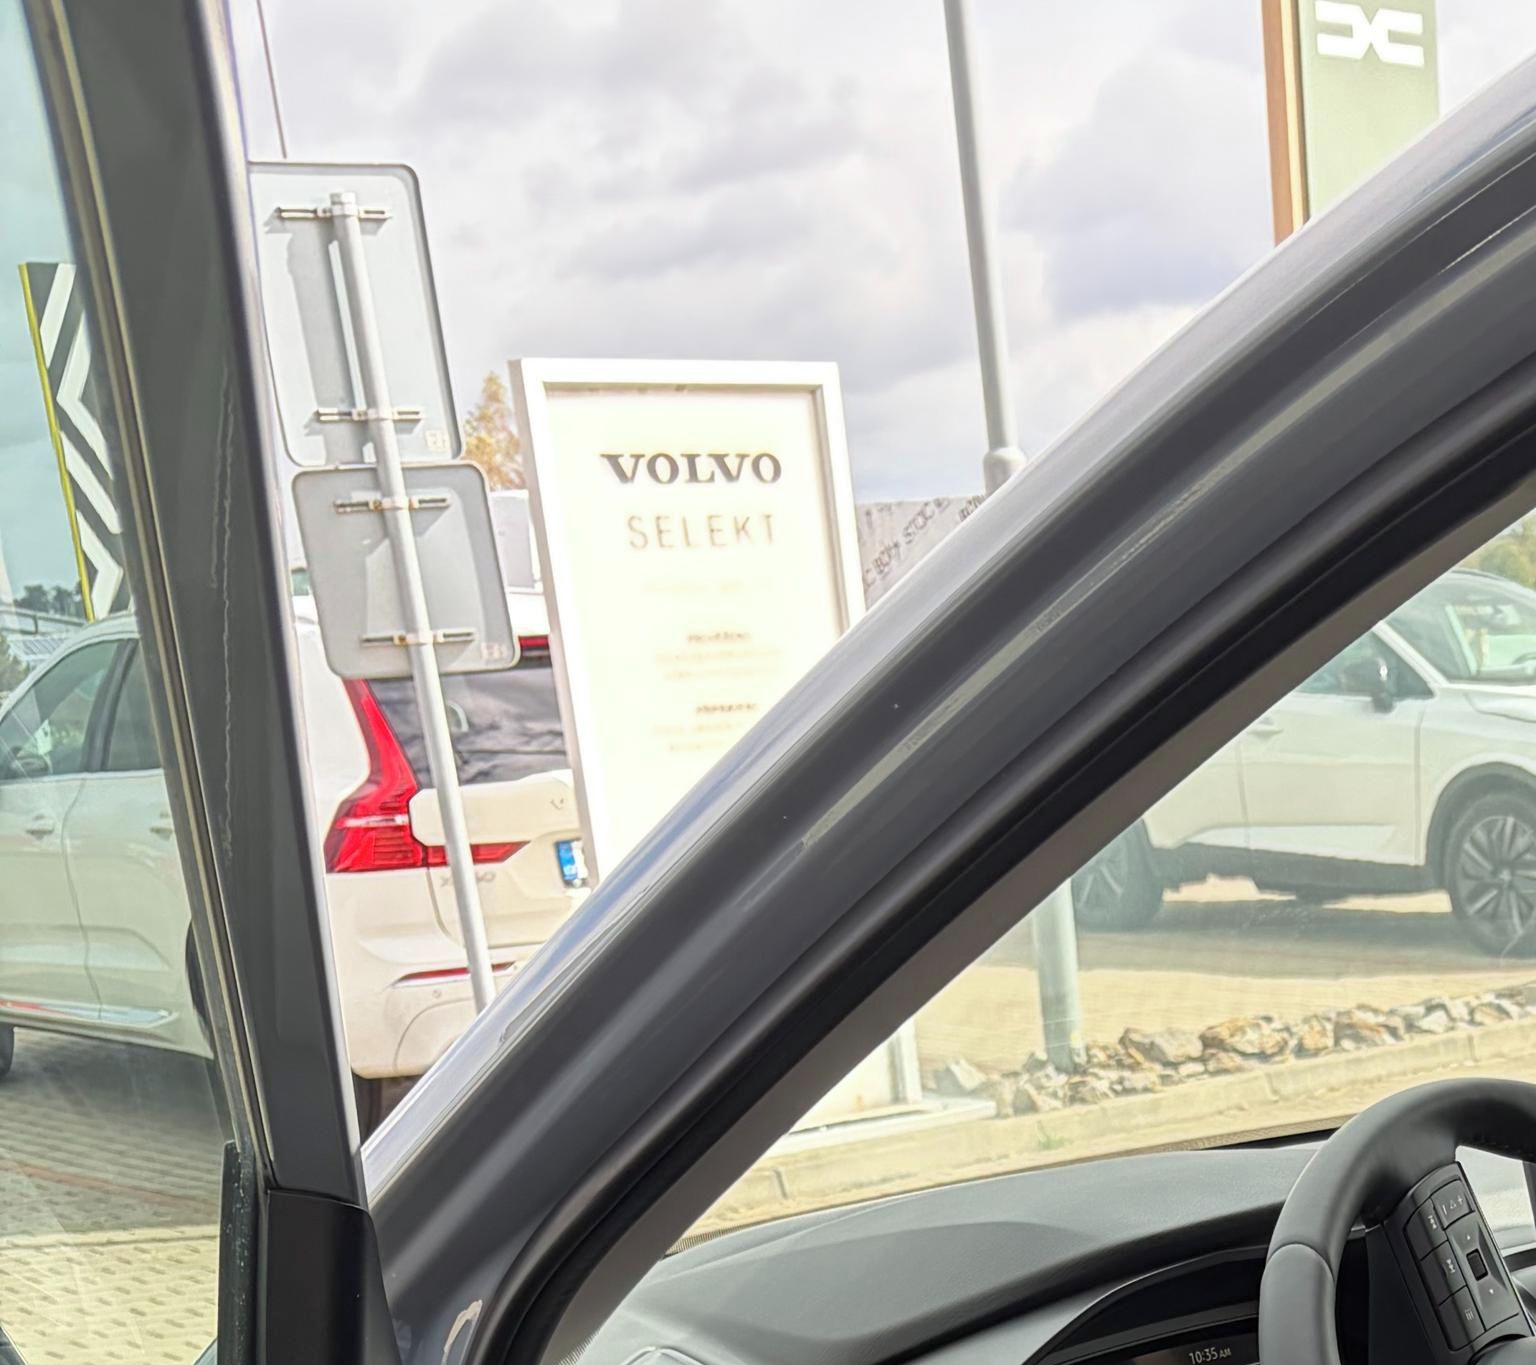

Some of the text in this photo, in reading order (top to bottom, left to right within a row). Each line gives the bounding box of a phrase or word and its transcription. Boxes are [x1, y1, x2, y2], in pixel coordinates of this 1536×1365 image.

[600, 452, 782, 485] VOLVO
[626, 513, 775, 550] SELEKT
[1188, 1346, 1232, 1365] 10:35 AM
